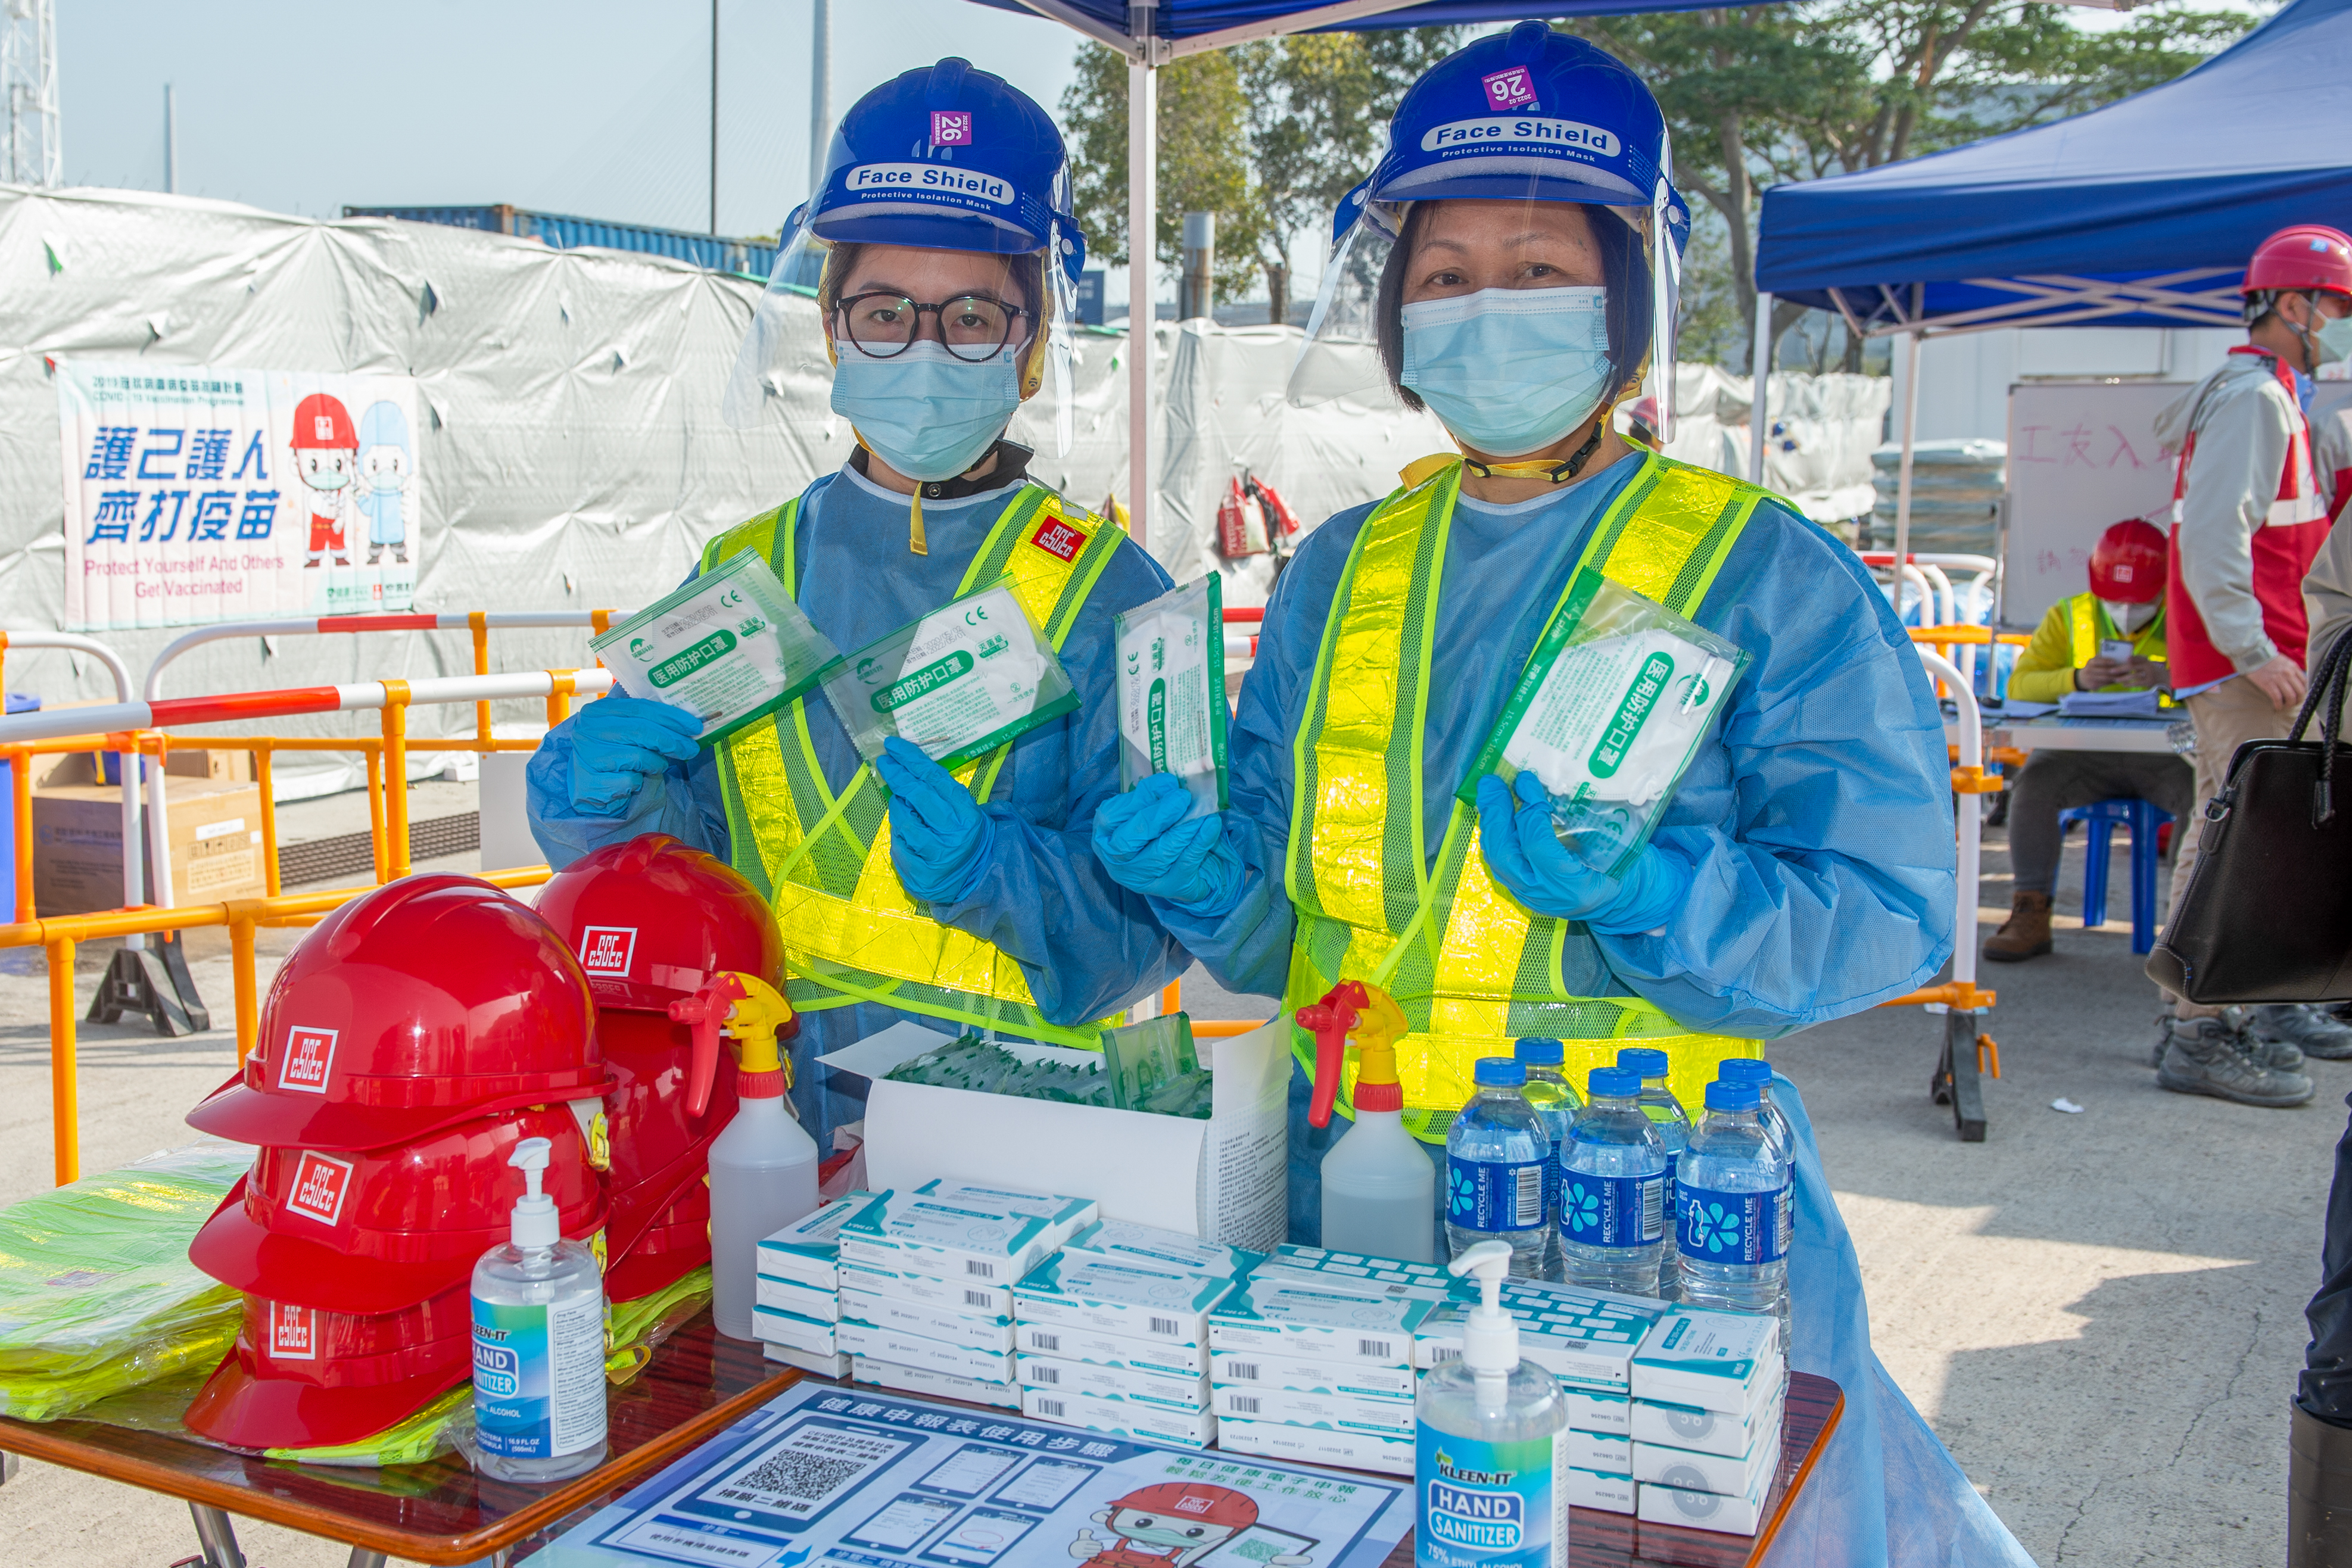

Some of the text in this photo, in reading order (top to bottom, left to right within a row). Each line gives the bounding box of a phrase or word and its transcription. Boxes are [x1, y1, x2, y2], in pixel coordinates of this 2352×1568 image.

[1491, 75, 1526, 101] 26
[1509, 93, 1532, 105] 2022.02
[942, 116, 962, 141] 26
[1436, 122, 1608, 150] Face Shield
[1442, 145, 1596, 162] Protective Isolation Mask
[857, 169, 1004, 199] Face Shield
[917, 193, 962, 204] Isolation
[966, 198, 992, 210] Mask
[85, 426, 270, 481] 護己護人
[85, 489, 281, 545] 齊打疫苗
[85, 553, 284, 576] Protect Yourself And Others
[135, 579, 242, 598] Get Vaccinated
[963, 605, 988, 628] CE
[977, 634, 1004, 652] 灭菌级
[651, 634, 729, 687] 医用防护口罩
[875, 655, 965, 711] 医用防护口罩
[1006, 687, 1036, 706] 一次性使用
[1594, 656, 1670, 769] 医用防护口罩
[1477, 1167, 1486, 1228] RECYCLE ME
[1603, 1180, 1612, 1243] RECYCLE ME
[847, 1223, 874, 1231] YHLO
[1744, 1198, 1753, 1261] RECYCLE ME
[1021, 1281, 1050, 1289] YHLO
[490, 1407, 521, 1418] ALCOHOL
[817, 1396, 1118, 1460] 健康申報表使用步驟
[1164, 1465, 1347, 1503] 輕鬆方便工作放心
[1174, 1457, 1359, 1495] 每日健康電子申報
[1438, 1487, 1511, 1518] HAND
[1435, 1514, 1516, 1546] SANITIZER
[1427, 1541, 1449, 1565] 75%
